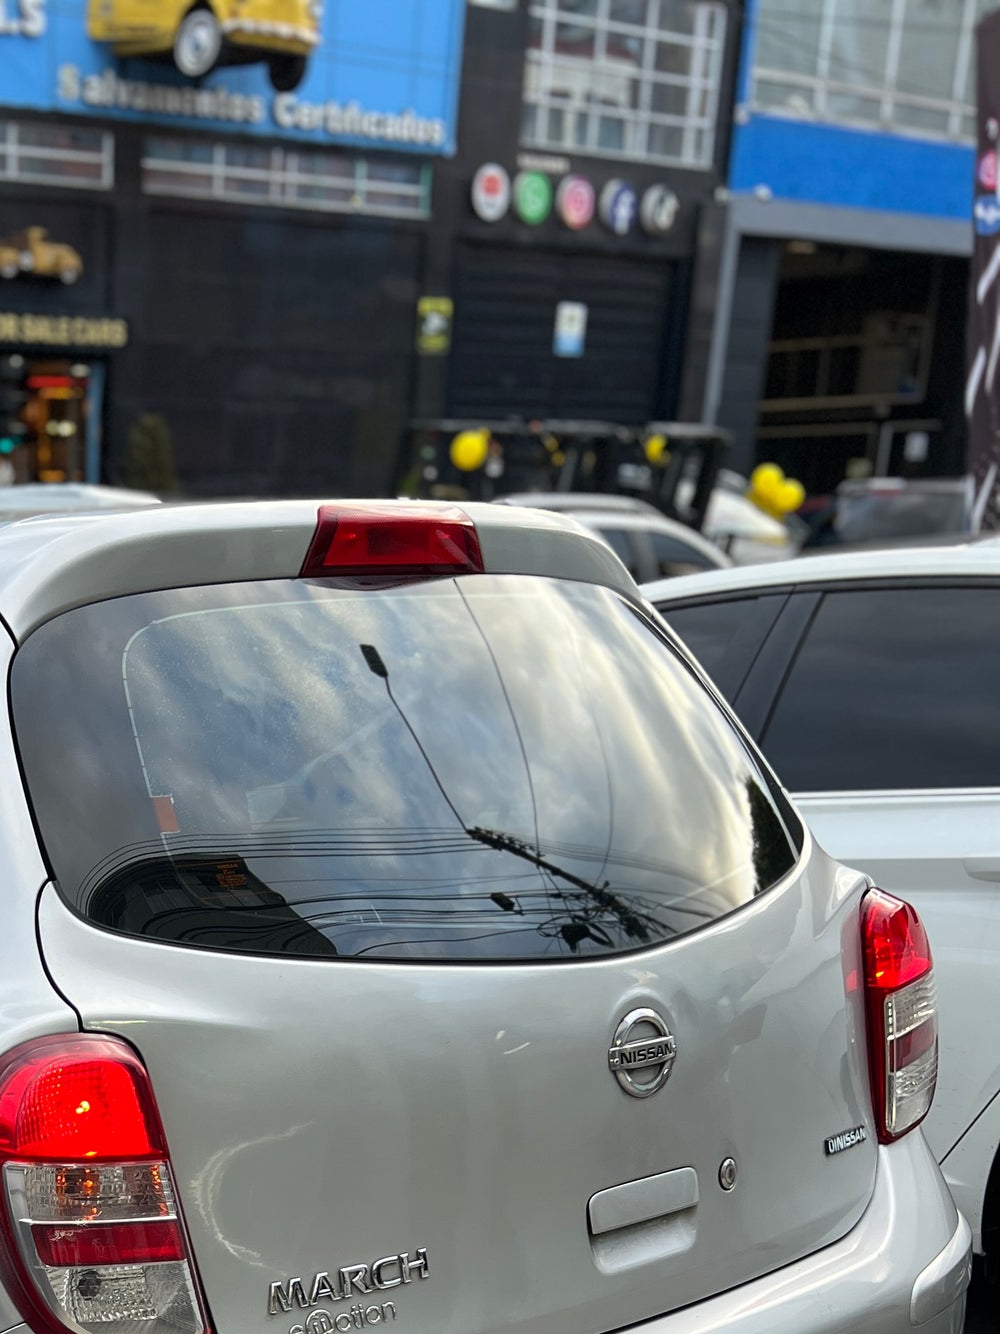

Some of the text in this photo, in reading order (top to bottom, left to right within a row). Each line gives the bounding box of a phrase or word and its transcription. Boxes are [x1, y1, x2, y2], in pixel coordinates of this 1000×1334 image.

[22, 313, 71, 345] SALE
[620, 1042, 672, 1065] NISSAN
[268, 1247, 430, 1315] MARCH
